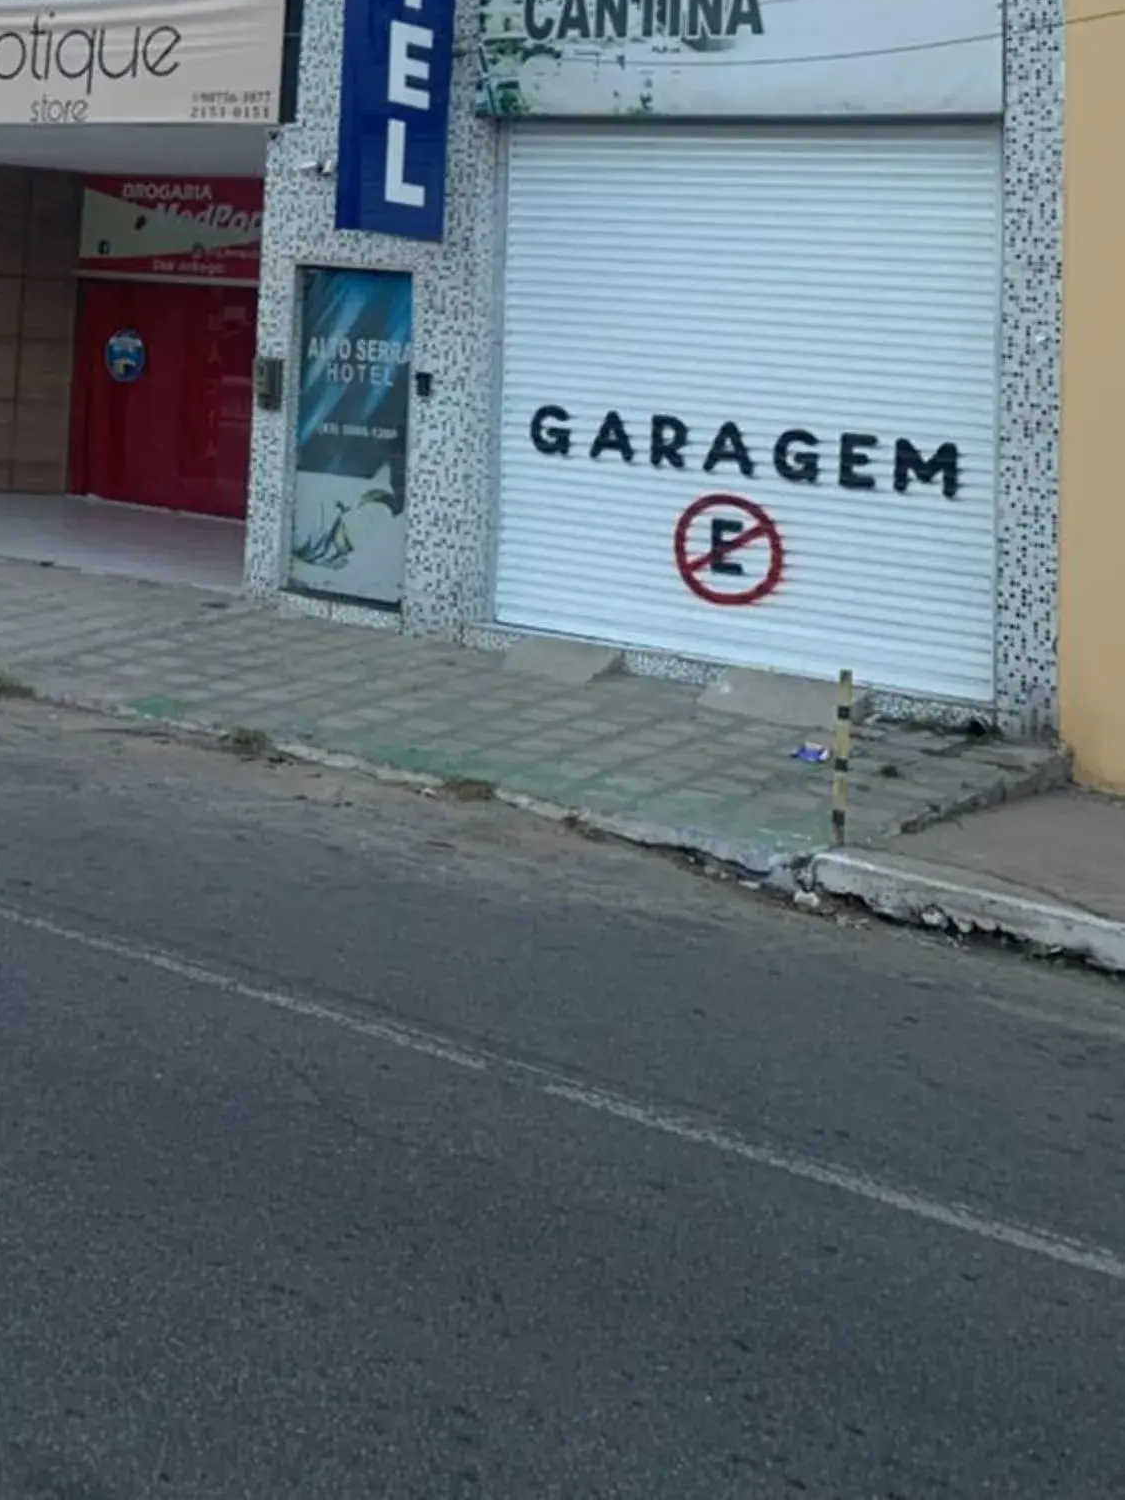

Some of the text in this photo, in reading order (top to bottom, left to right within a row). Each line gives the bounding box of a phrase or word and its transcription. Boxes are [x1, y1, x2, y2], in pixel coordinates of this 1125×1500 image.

[28, 92, 90, 125] store
[123, 182, 213, 199] DROGARIA
[307, 337, 412, 363] ALTO SERRA
[326, 361, 393, 387] HOTEL
[529, 404, 961, 501] GARAGEM
[709, 518, 745, 576] E
